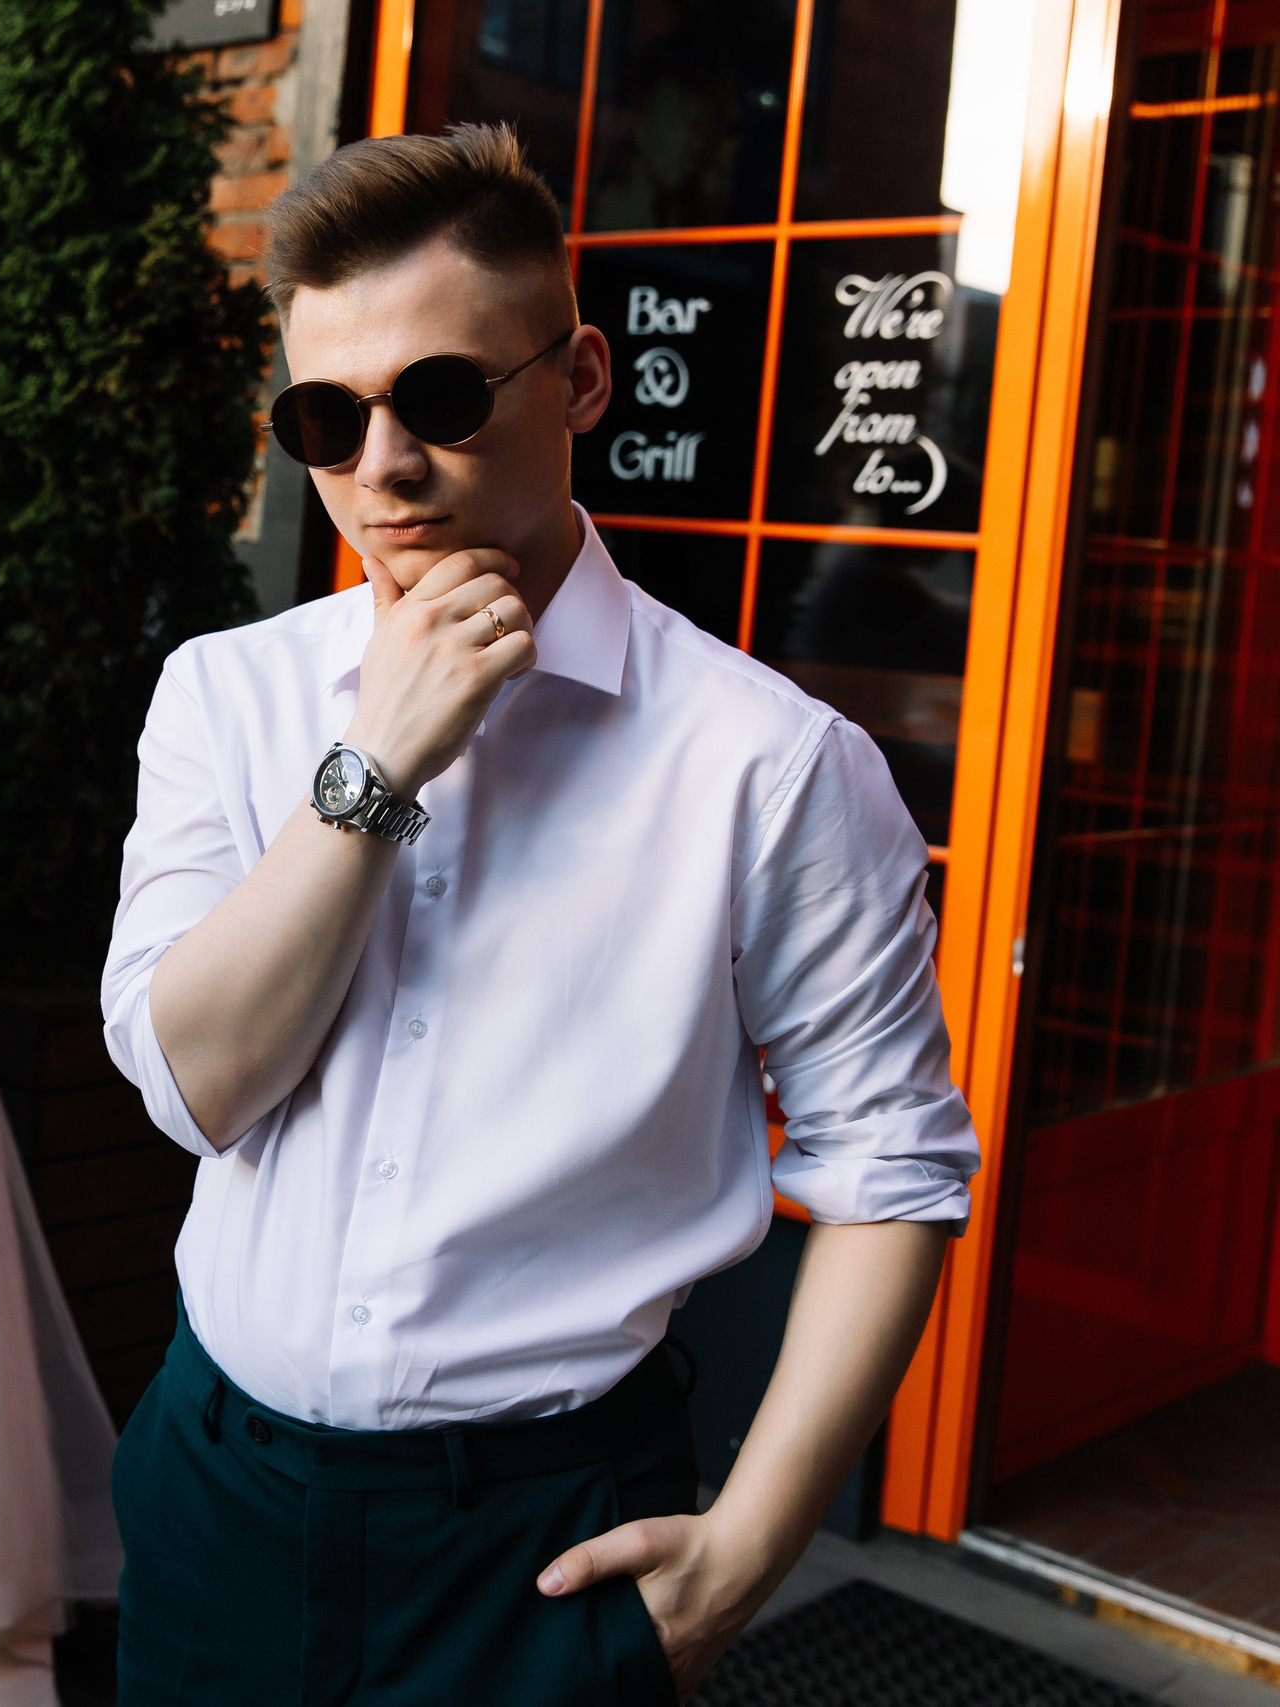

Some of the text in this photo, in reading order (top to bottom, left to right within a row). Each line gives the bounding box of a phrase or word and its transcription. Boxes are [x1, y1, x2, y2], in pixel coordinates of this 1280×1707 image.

[627, 285, 712, 335] Bar
[834, 269, 954, 340] We're
[634, 346, 690, 408] &
[833, 359, 922, 404] open
[813, 391, 922, 456] from
[609, 430, 706, 482] Grill
